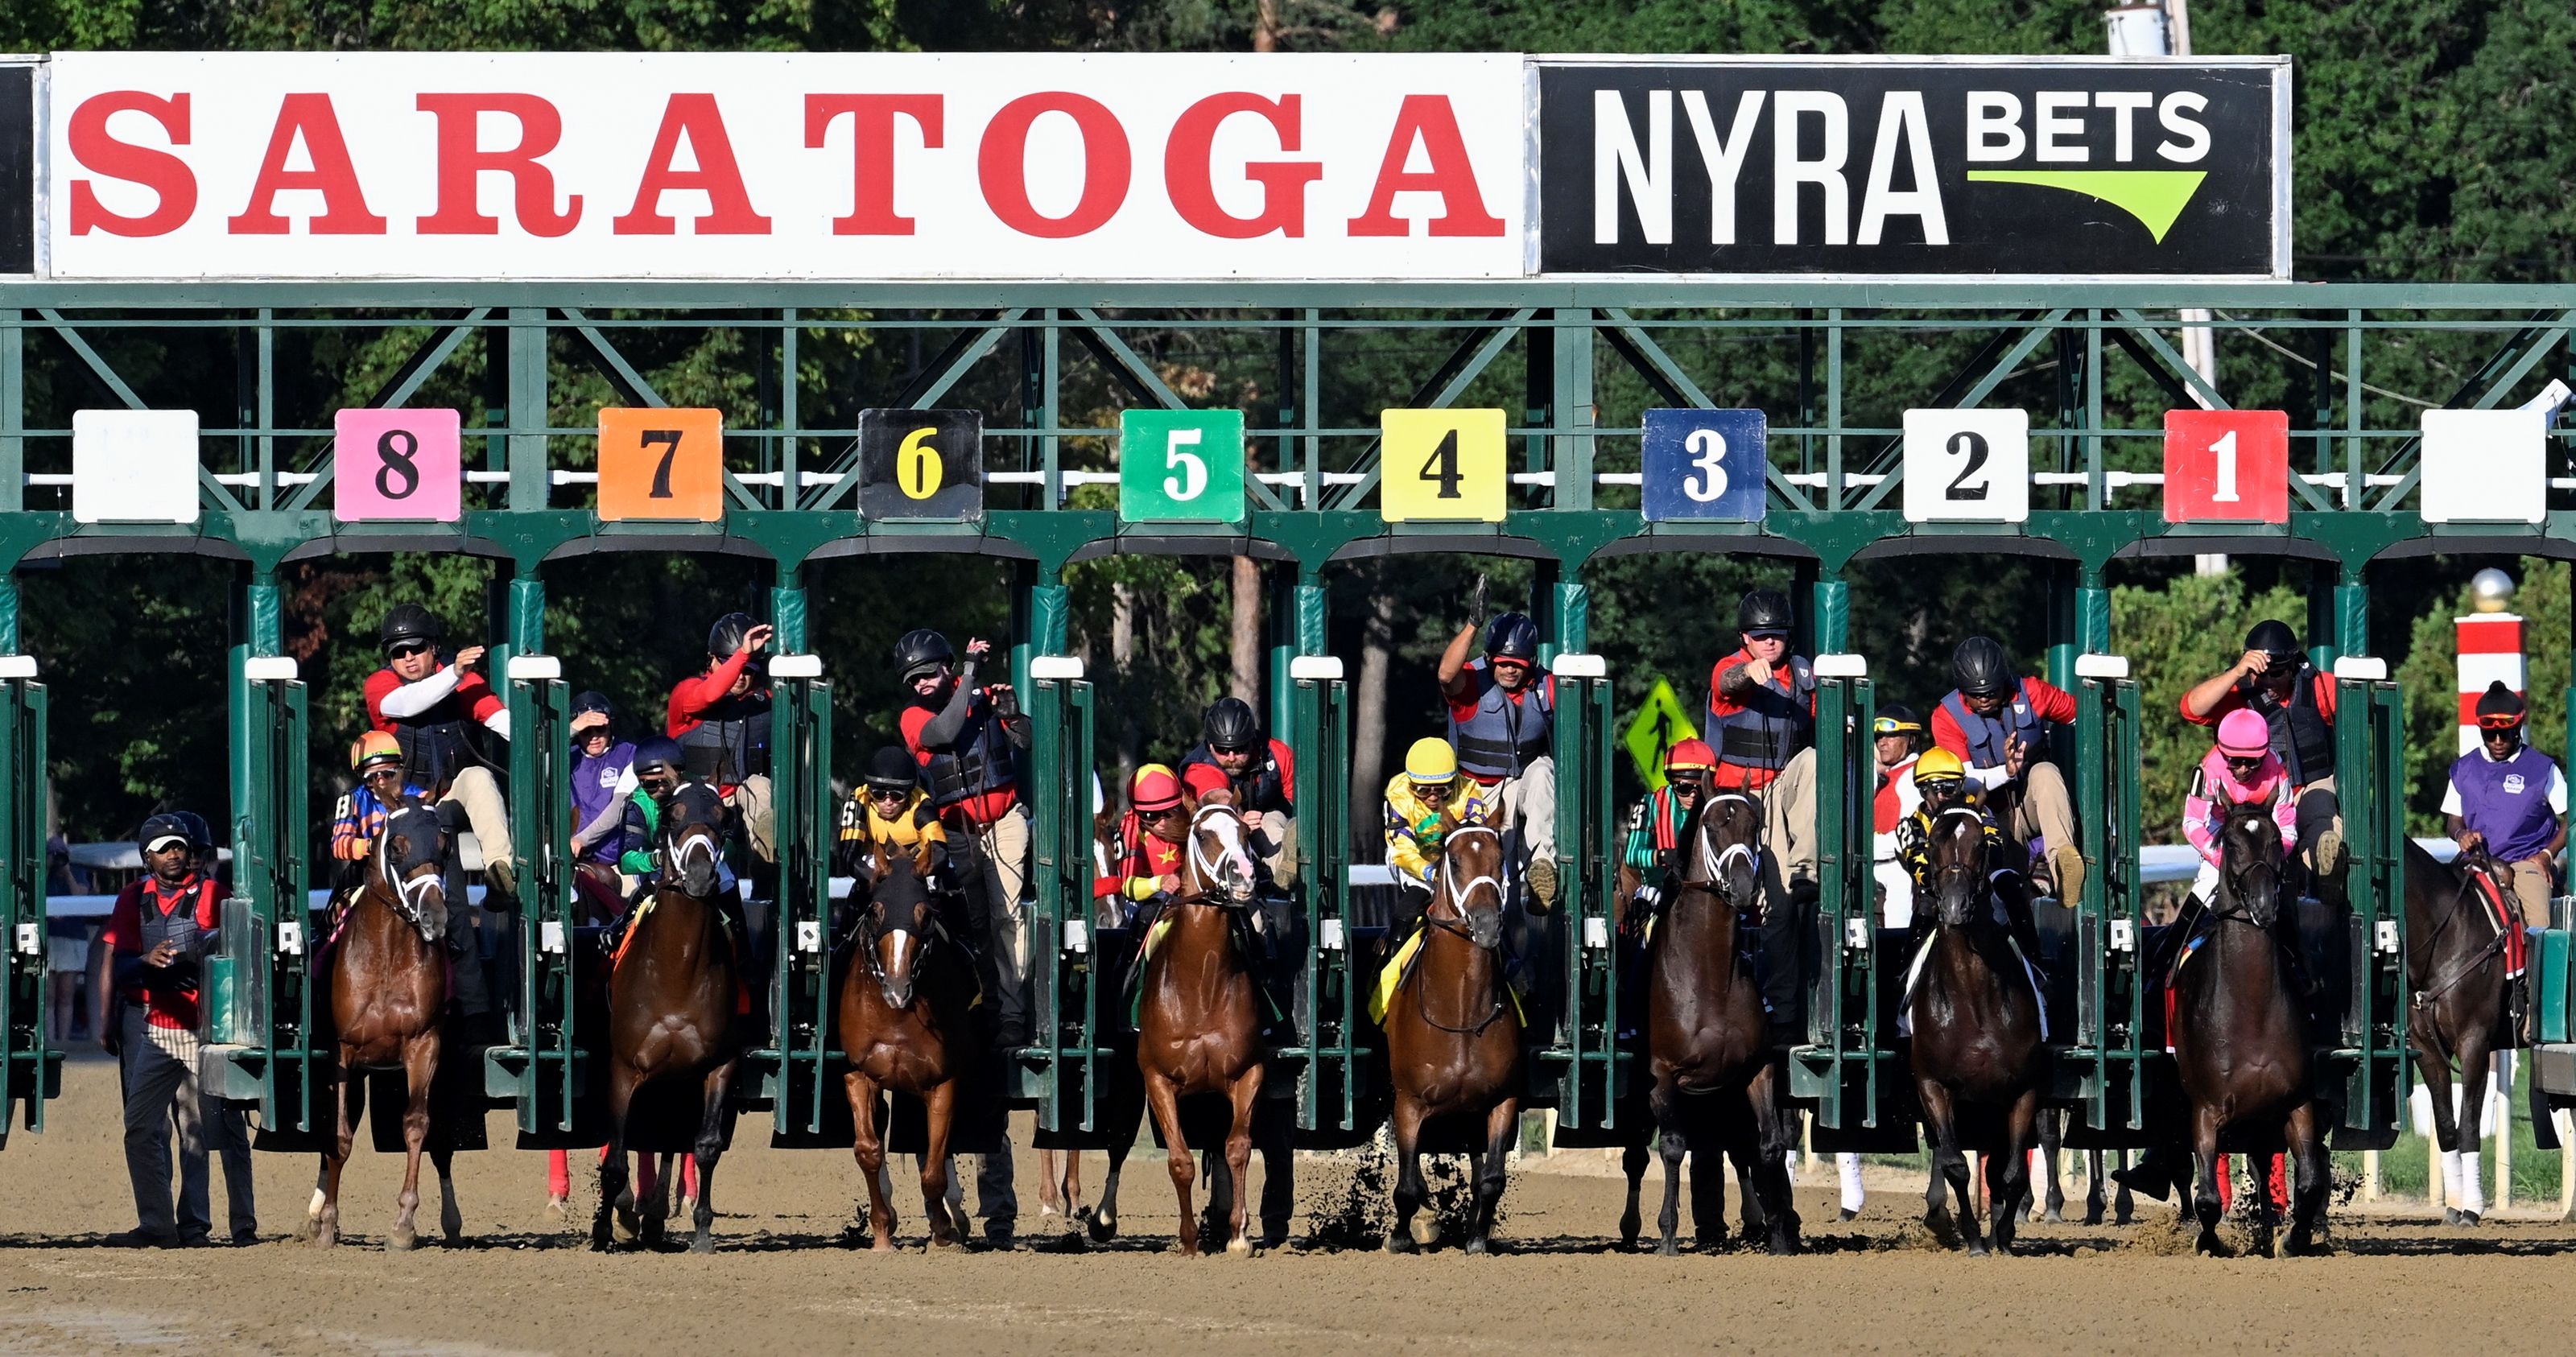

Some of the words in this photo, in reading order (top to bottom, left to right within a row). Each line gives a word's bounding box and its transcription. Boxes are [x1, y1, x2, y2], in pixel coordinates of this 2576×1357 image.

[68, 90, 1505, 239] SARATOGA
[1594, 89, 1950, 245] NYRA
[1967, 90, 2211, 163] BETS
[375, 430, 419, 500] 8
[640, 430, 683, 498] 7
[896, 427, 943, 501] 6
[1163, 428, 1208, 501] 5
[1419, 429, 1464, 498] 4
[1683, 429, 1728, 502] 3
[1945, 431, 1989, 501] 2
[2208, 430, 2240, 502] 1
[841, 801, 856, 827] 6
[1897, 820, 1915, 850] 2
